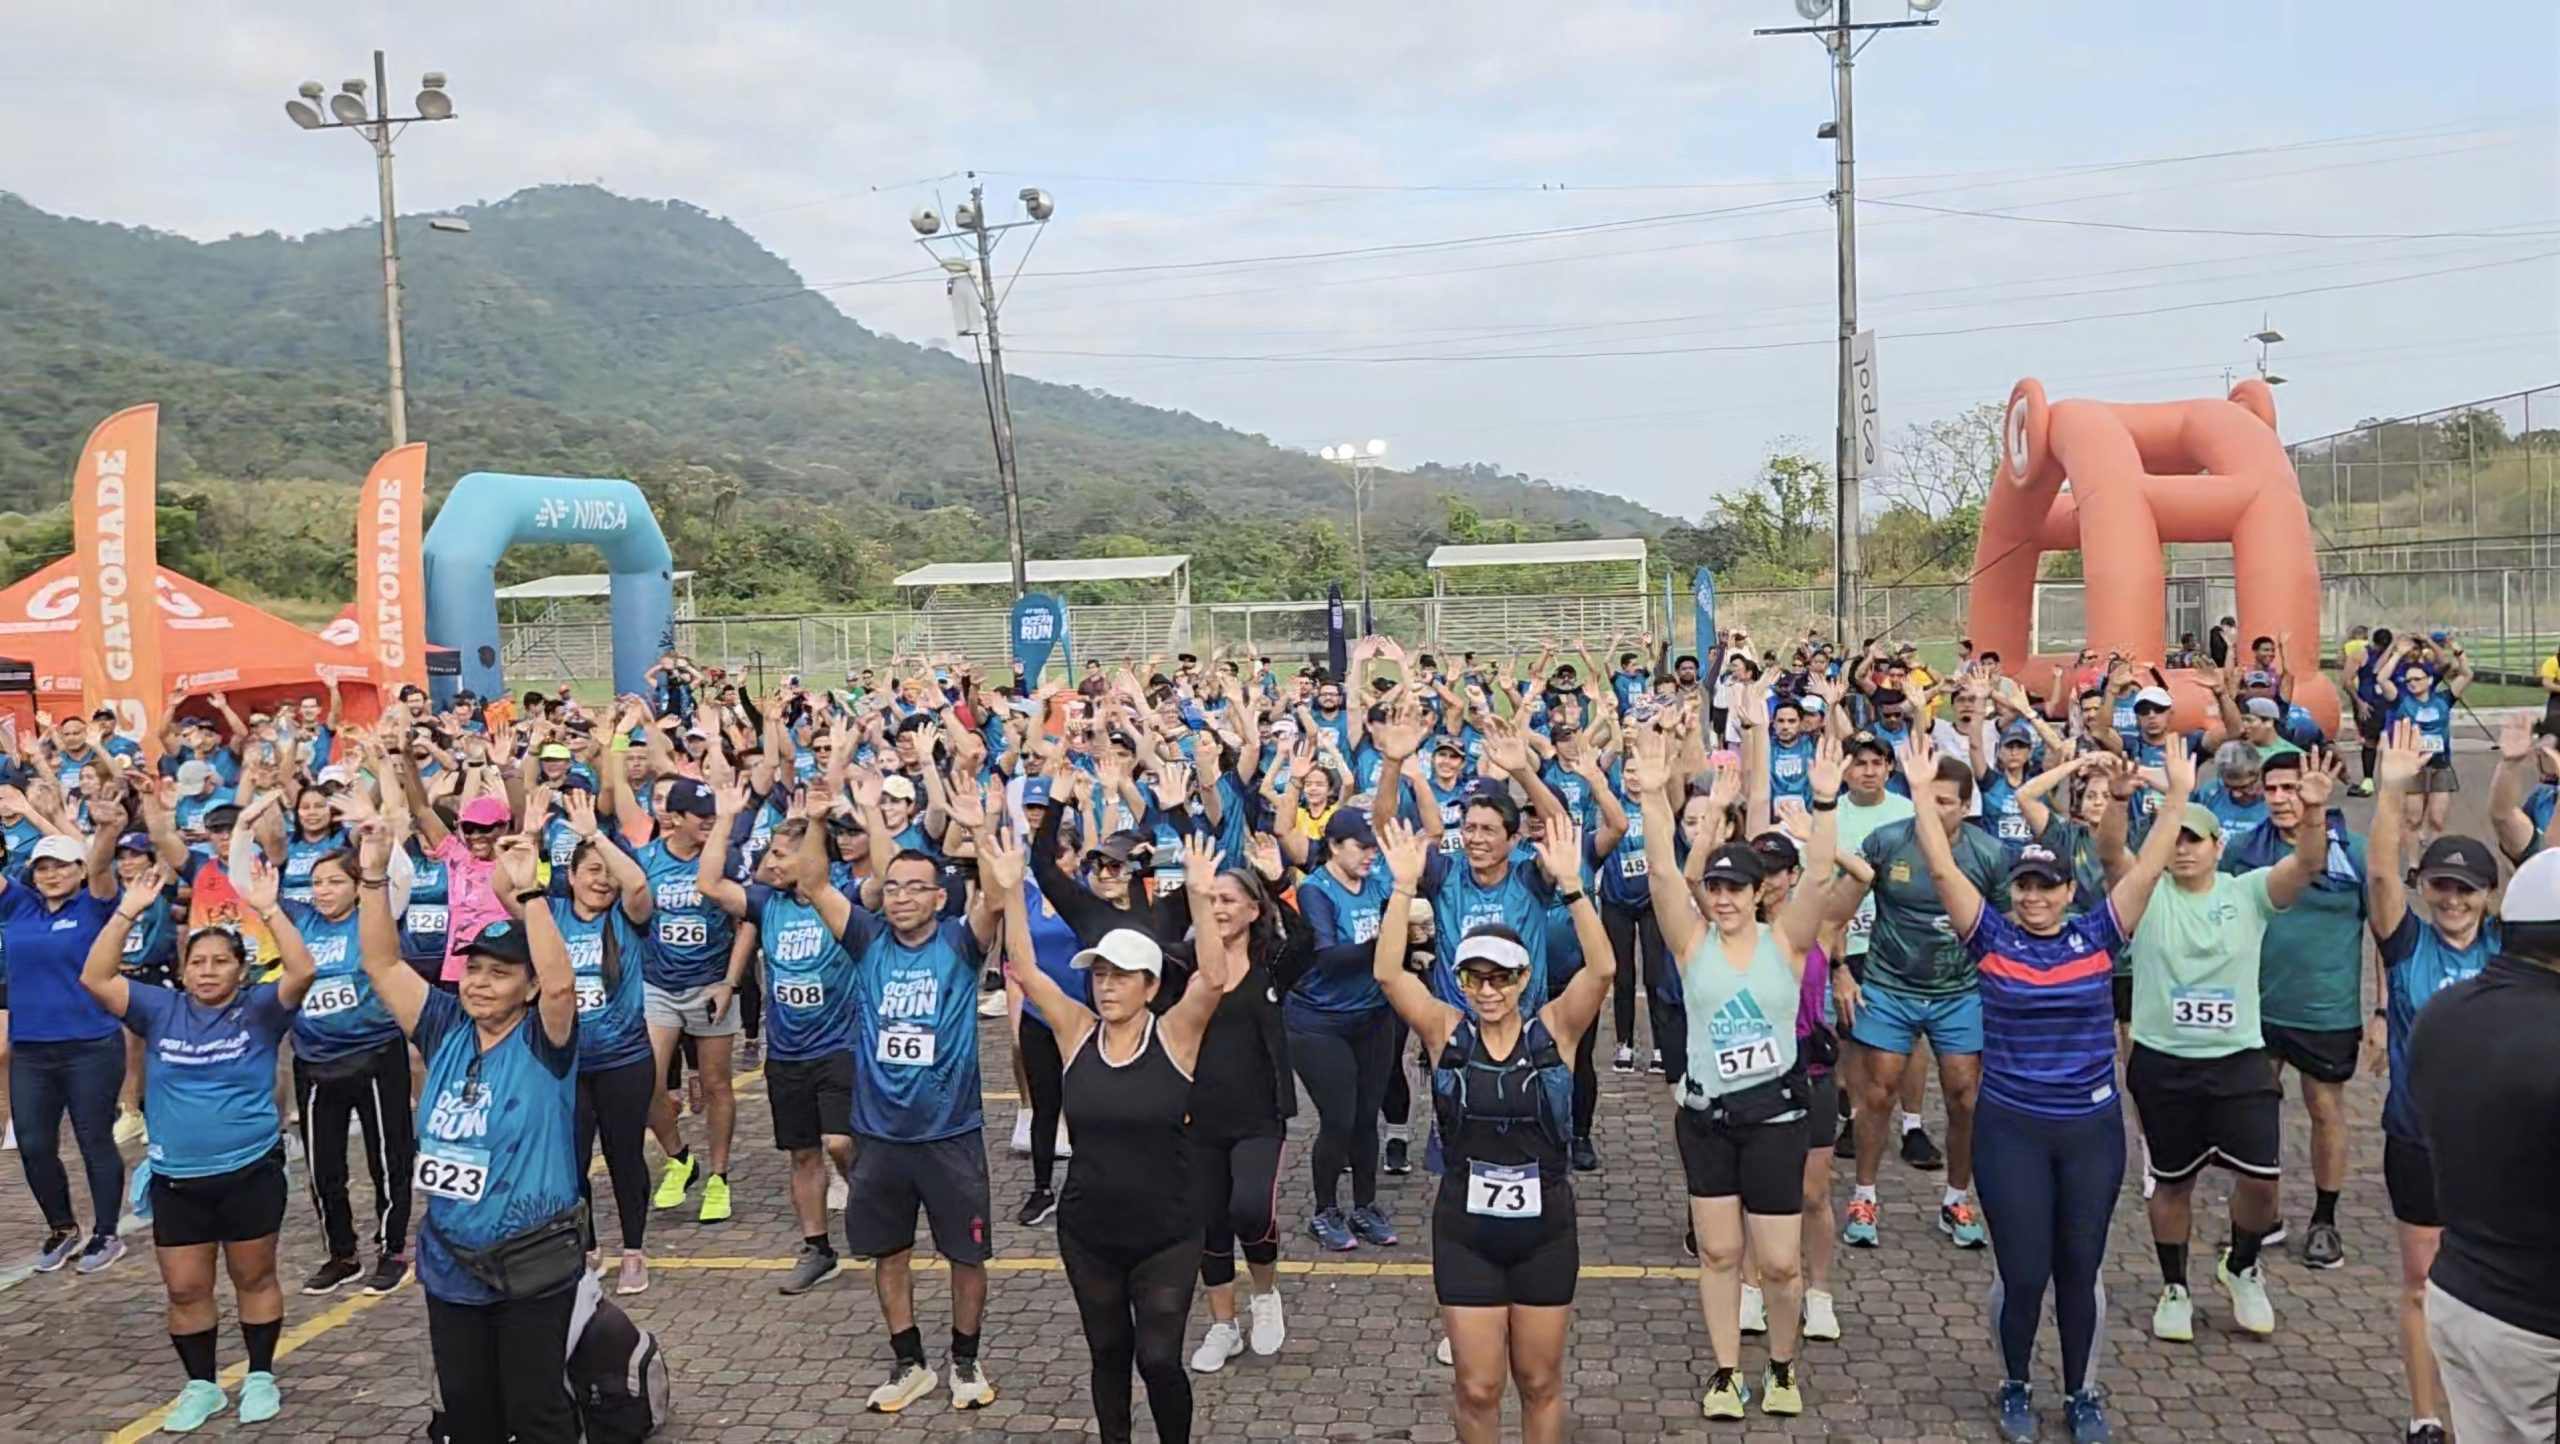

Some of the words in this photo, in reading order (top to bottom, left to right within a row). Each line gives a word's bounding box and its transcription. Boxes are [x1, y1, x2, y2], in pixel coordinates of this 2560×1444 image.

[572, 499, 628, 530] NIRSA
[95, 449, 134, 681] GATORADE
[376, 478, 406, 668] GATORADE
[1021, 614, 1054, 627] OCEAN
[1020, 625, 1053, 640] RUN
[1624, 859, 1646, 873] 48
[662, 925, 704, 942] 526
[778, 927, 823, 944] OCEAN
[775, 939, 821, 961] RUN
[777, 986, 821, 1005] 508
[883, 977, 939, 997] OCEAN
[306, 988, 355, 1012] 466
[878, 992, 937, 1018] RUN
[2175, 1001, 2234, 1024] 355
[887, 1036, 921, 1059] 66
[1719, 1041, 1776, 1075] 571
[426, 1108, 489, 1140] RUN
[420, 1159, 482, 1196] 623
[1483, 1182, 1526, 1211] 73
